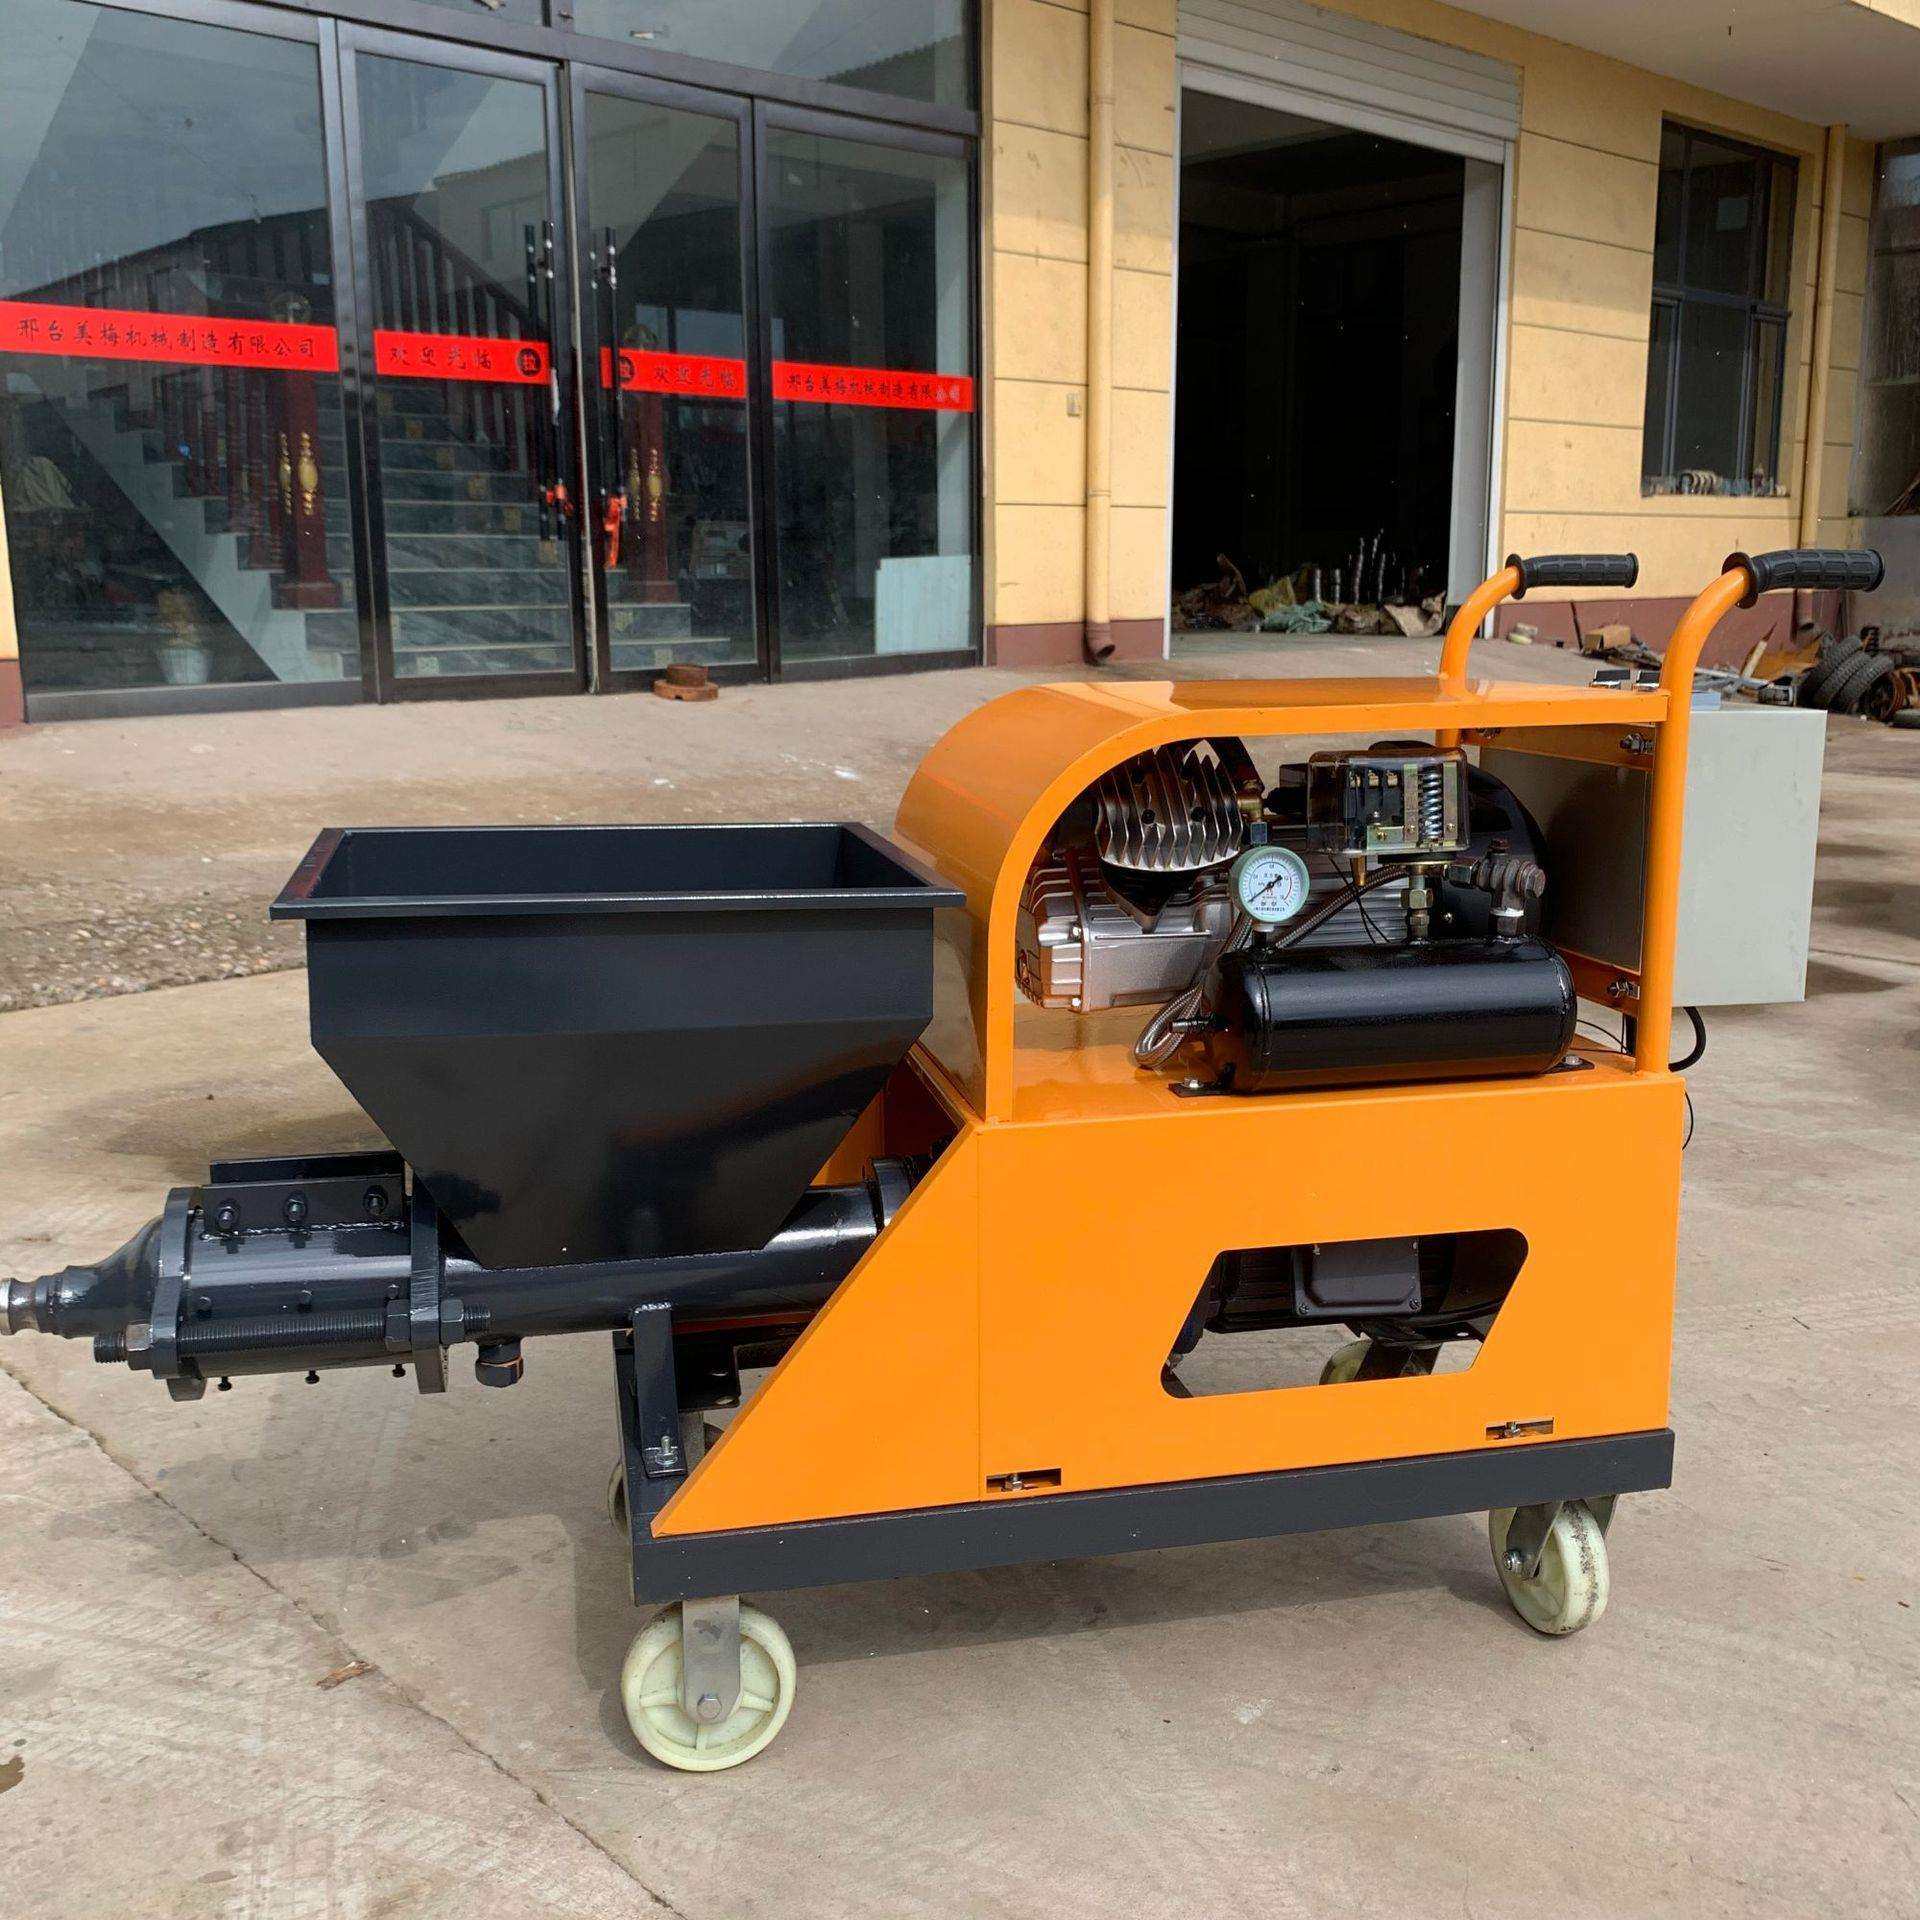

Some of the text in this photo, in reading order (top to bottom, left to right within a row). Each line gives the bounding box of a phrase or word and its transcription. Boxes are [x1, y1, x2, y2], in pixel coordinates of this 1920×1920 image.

[17, 317, 314, 358] 邢台美梅机械制造有限公司
[390, 345, 493, 370] 欢迎光临
